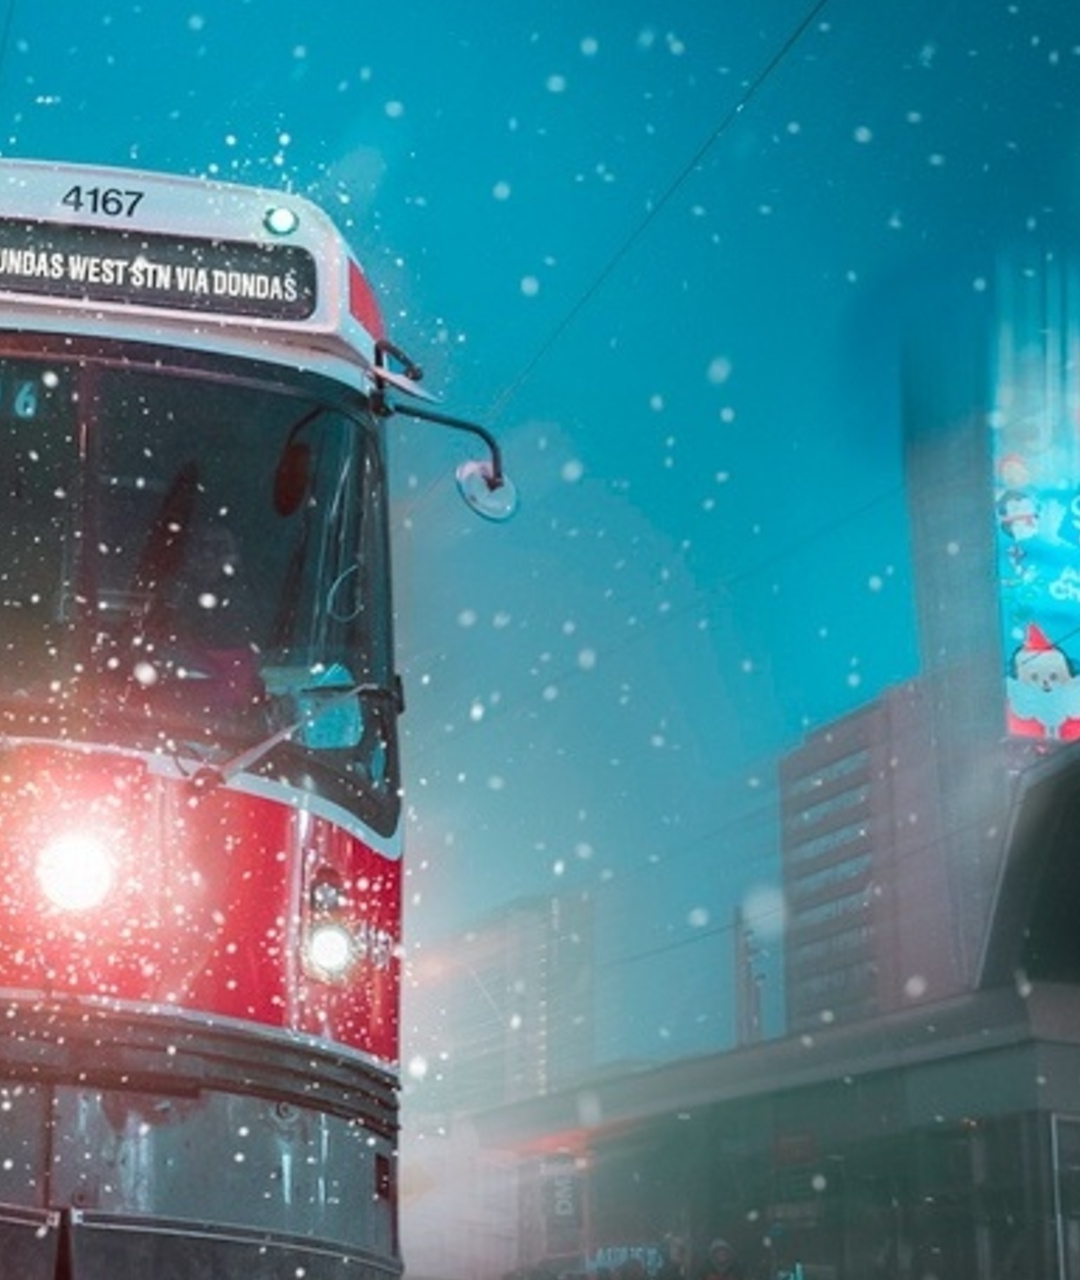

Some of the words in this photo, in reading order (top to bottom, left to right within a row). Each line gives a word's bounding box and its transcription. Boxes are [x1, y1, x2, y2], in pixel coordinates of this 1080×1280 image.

[61, 184, 144, 218] 4167
[68, 254, 131, 286] WEST
[129, 255, 171, 292] STN
[175, 266, 211, 295] VIA
[212, 271, 298, 302] DUNDAS
